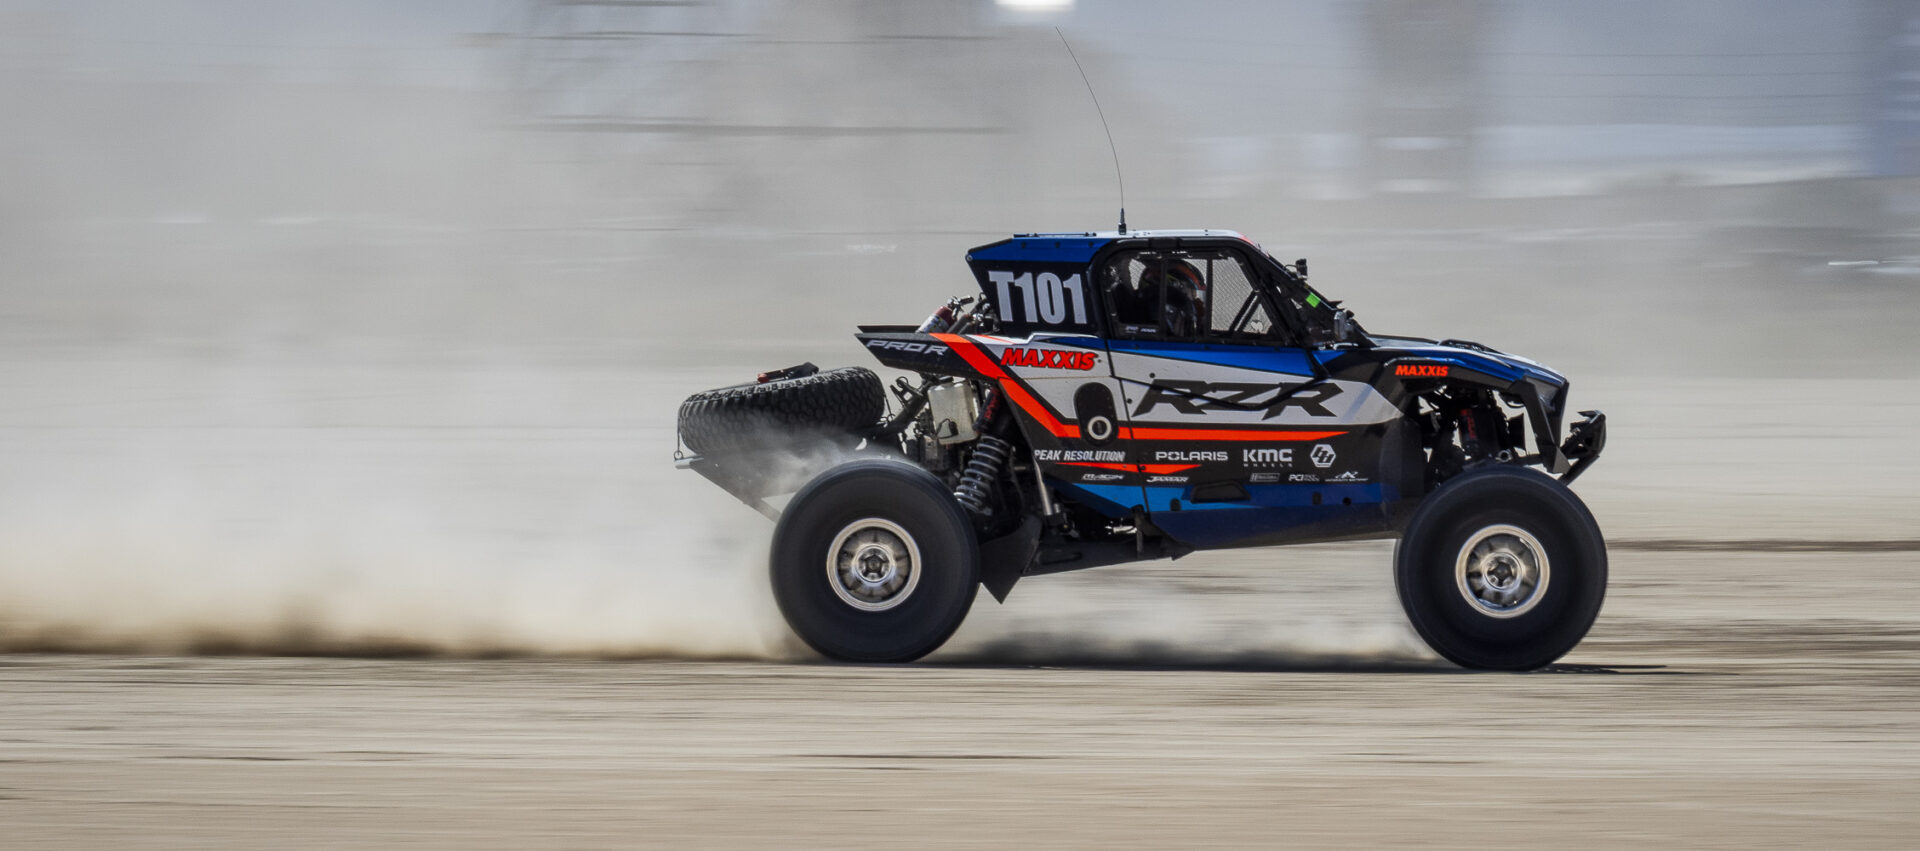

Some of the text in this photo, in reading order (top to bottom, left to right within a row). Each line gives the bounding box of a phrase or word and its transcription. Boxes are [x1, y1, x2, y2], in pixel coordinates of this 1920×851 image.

[988, 271, 1087, 324] T101
[866, 340, 949, 356] PRO R
[1001, 348, 1098, 370] MAXXIS
[1395, 364, 1449, 376] MAXXIS
[1131, 379, 1344, 421] RZR
[1034, 449, 1126, 462] PEAK RESOLUTION
[1155, 451, 1229, 461] POLARIS
[1243, 449, 1293, 462] KMC
